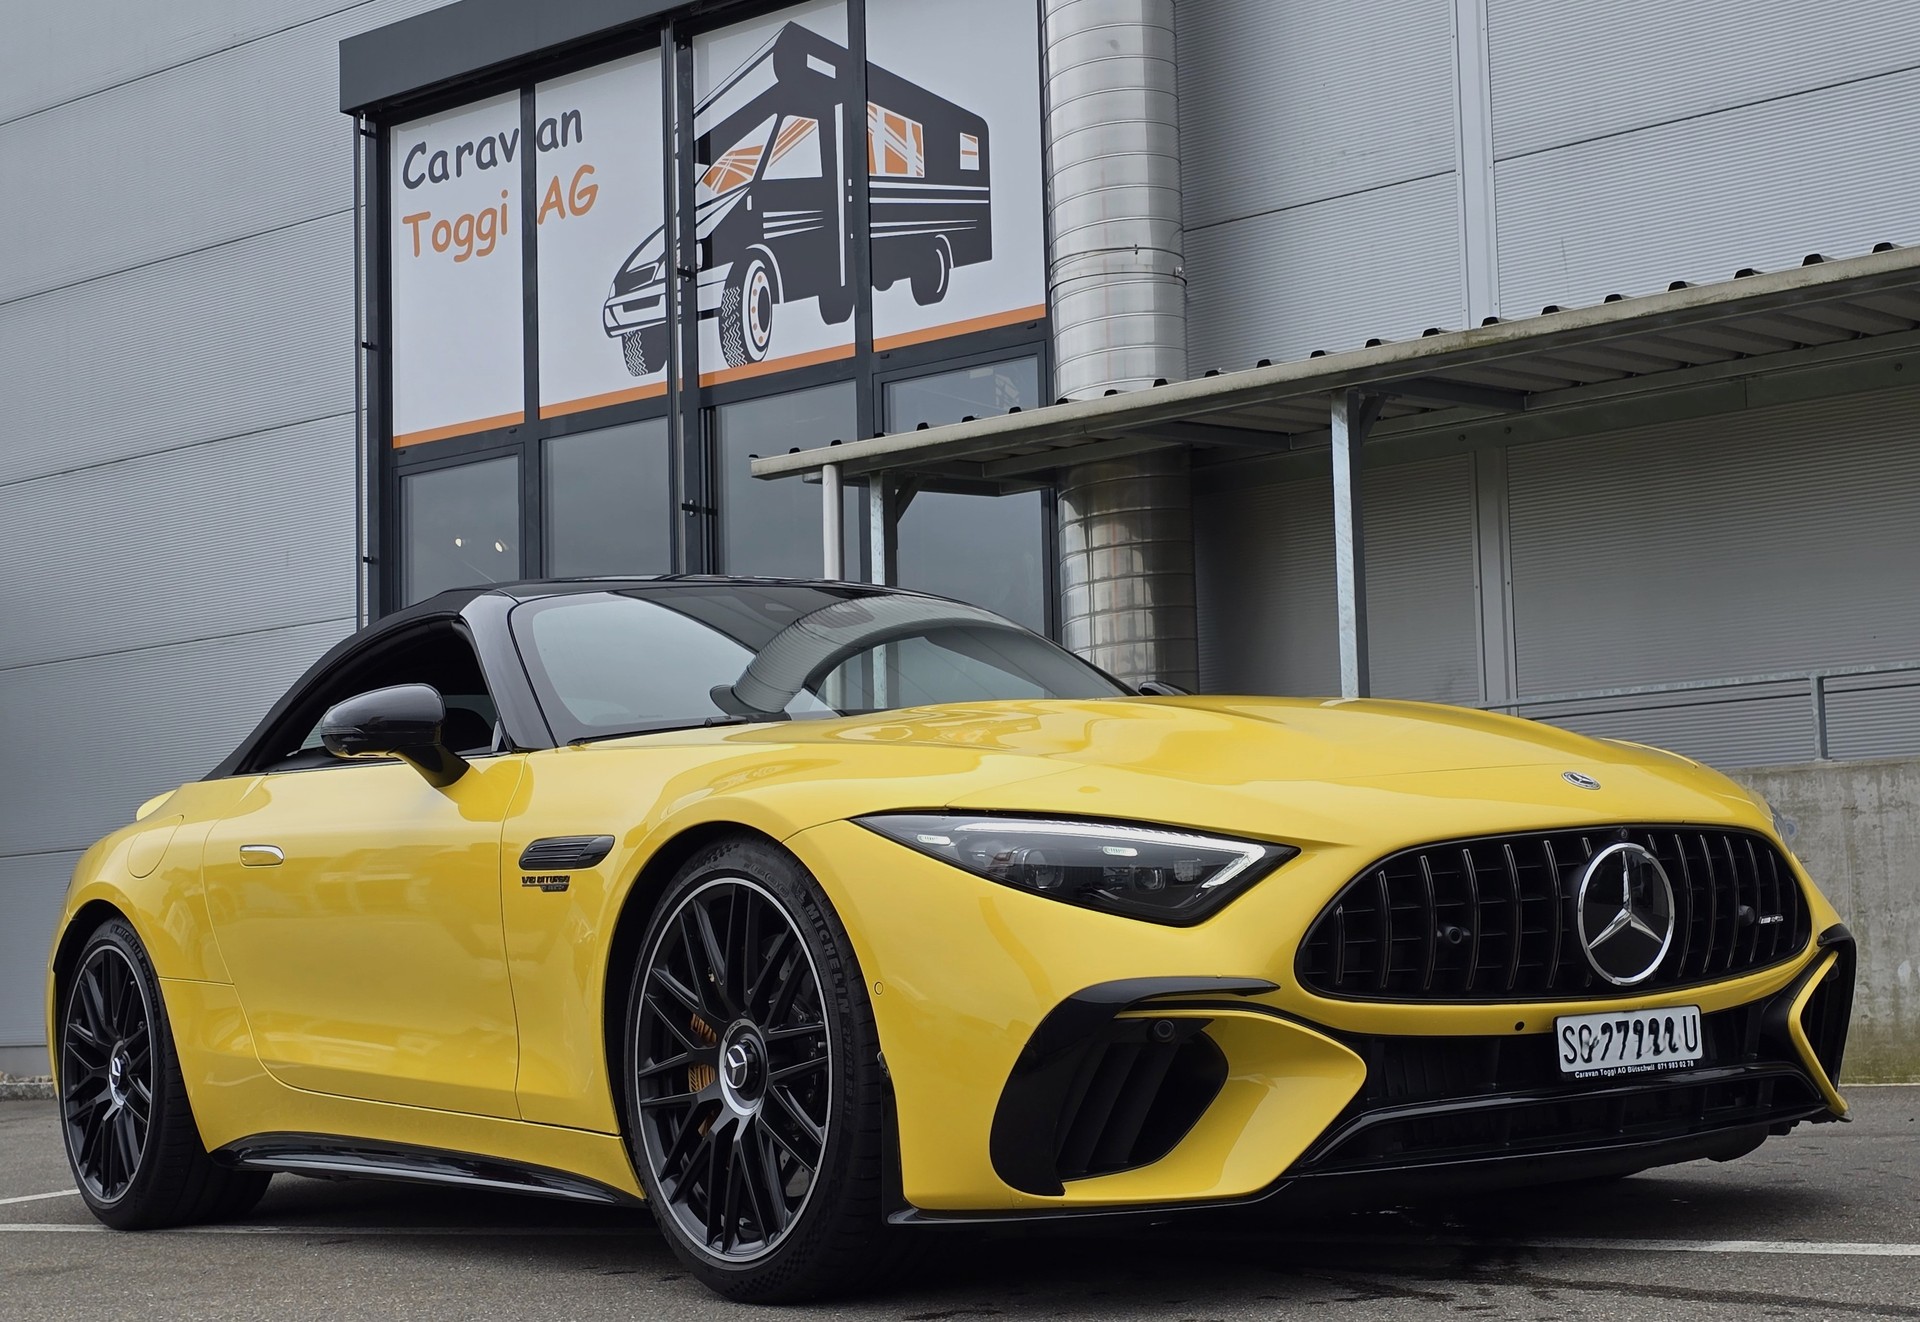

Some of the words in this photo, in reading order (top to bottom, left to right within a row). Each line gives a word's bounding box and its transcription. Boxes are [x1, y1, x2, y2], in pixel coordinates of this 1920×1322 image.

[402, 109, 583, 190] Caravan
[402, 189, 509, 263] Toggi
[537, 164, 599, 226] AG
[805, 903, 851, 1014] MICHELIN
[1574, 1071, 1599, 1079] Caravan
[1600, 1068, 1617, 1077] Toggi
